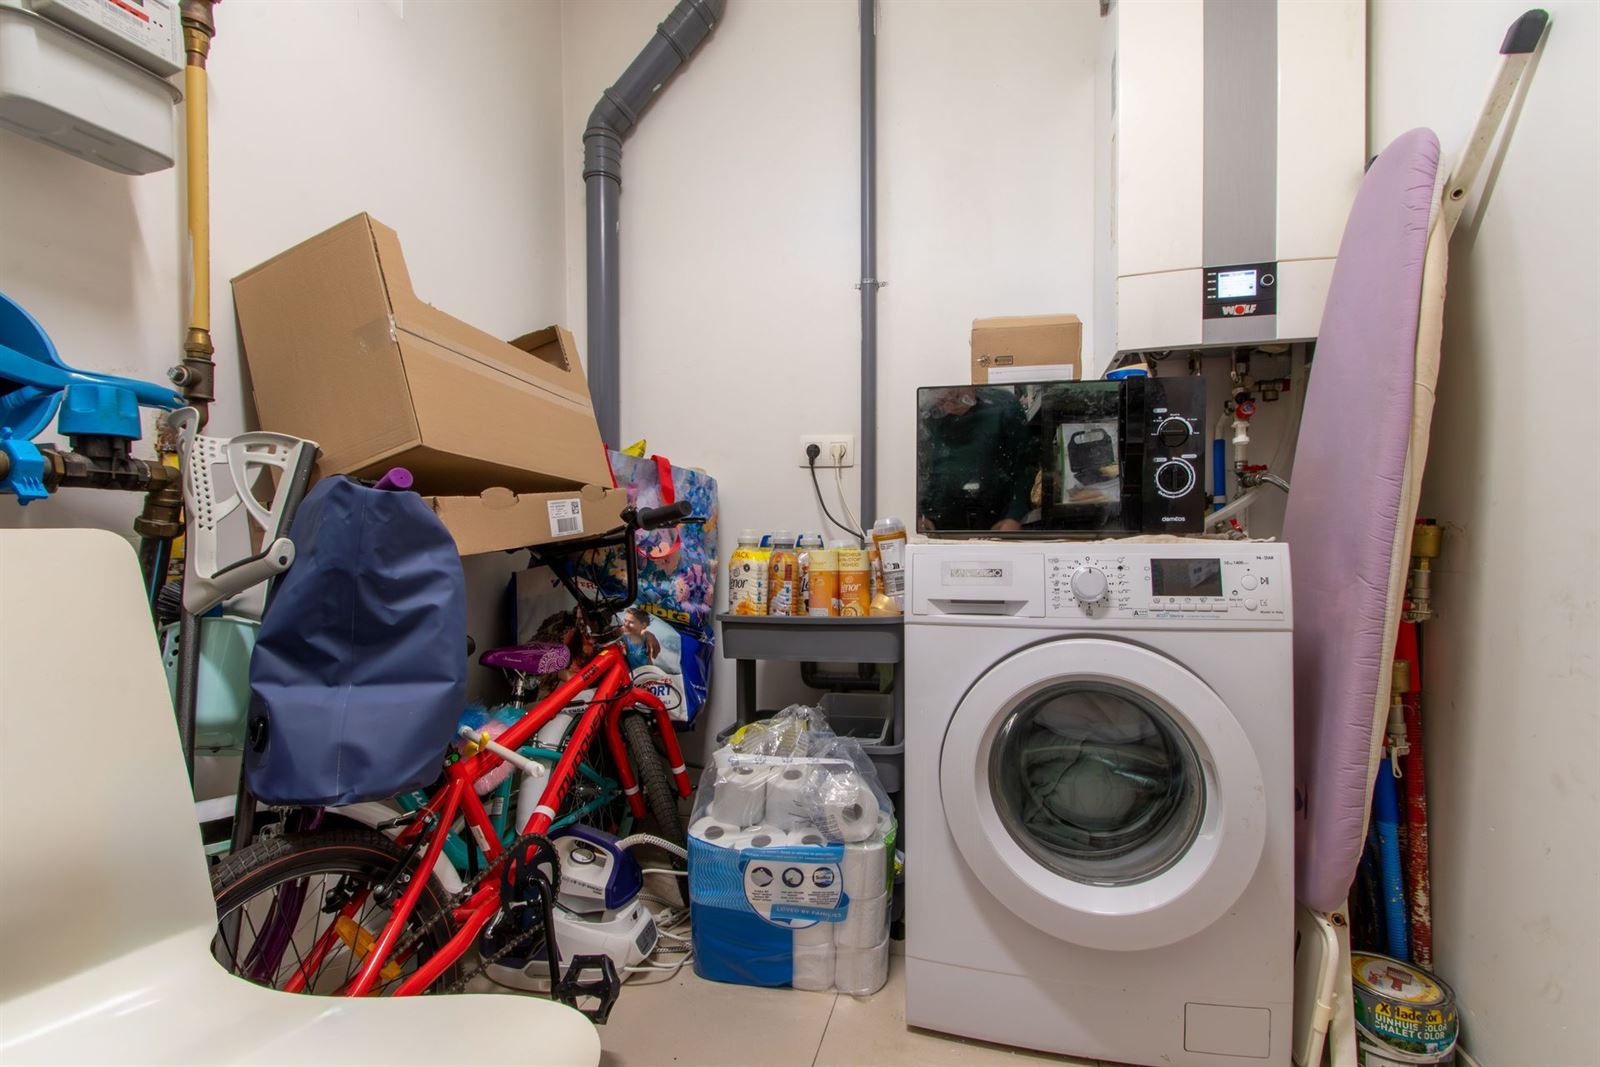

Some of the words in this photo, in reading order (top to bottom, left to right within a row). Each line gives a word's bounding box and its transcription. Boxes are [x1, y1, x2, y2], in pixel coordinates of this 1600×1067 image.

[1222, 304, 1257, 316] WOLF
[649, 685, 671, 697] ORT
[1375, 1013, 1418, 1032] UINHUIS
